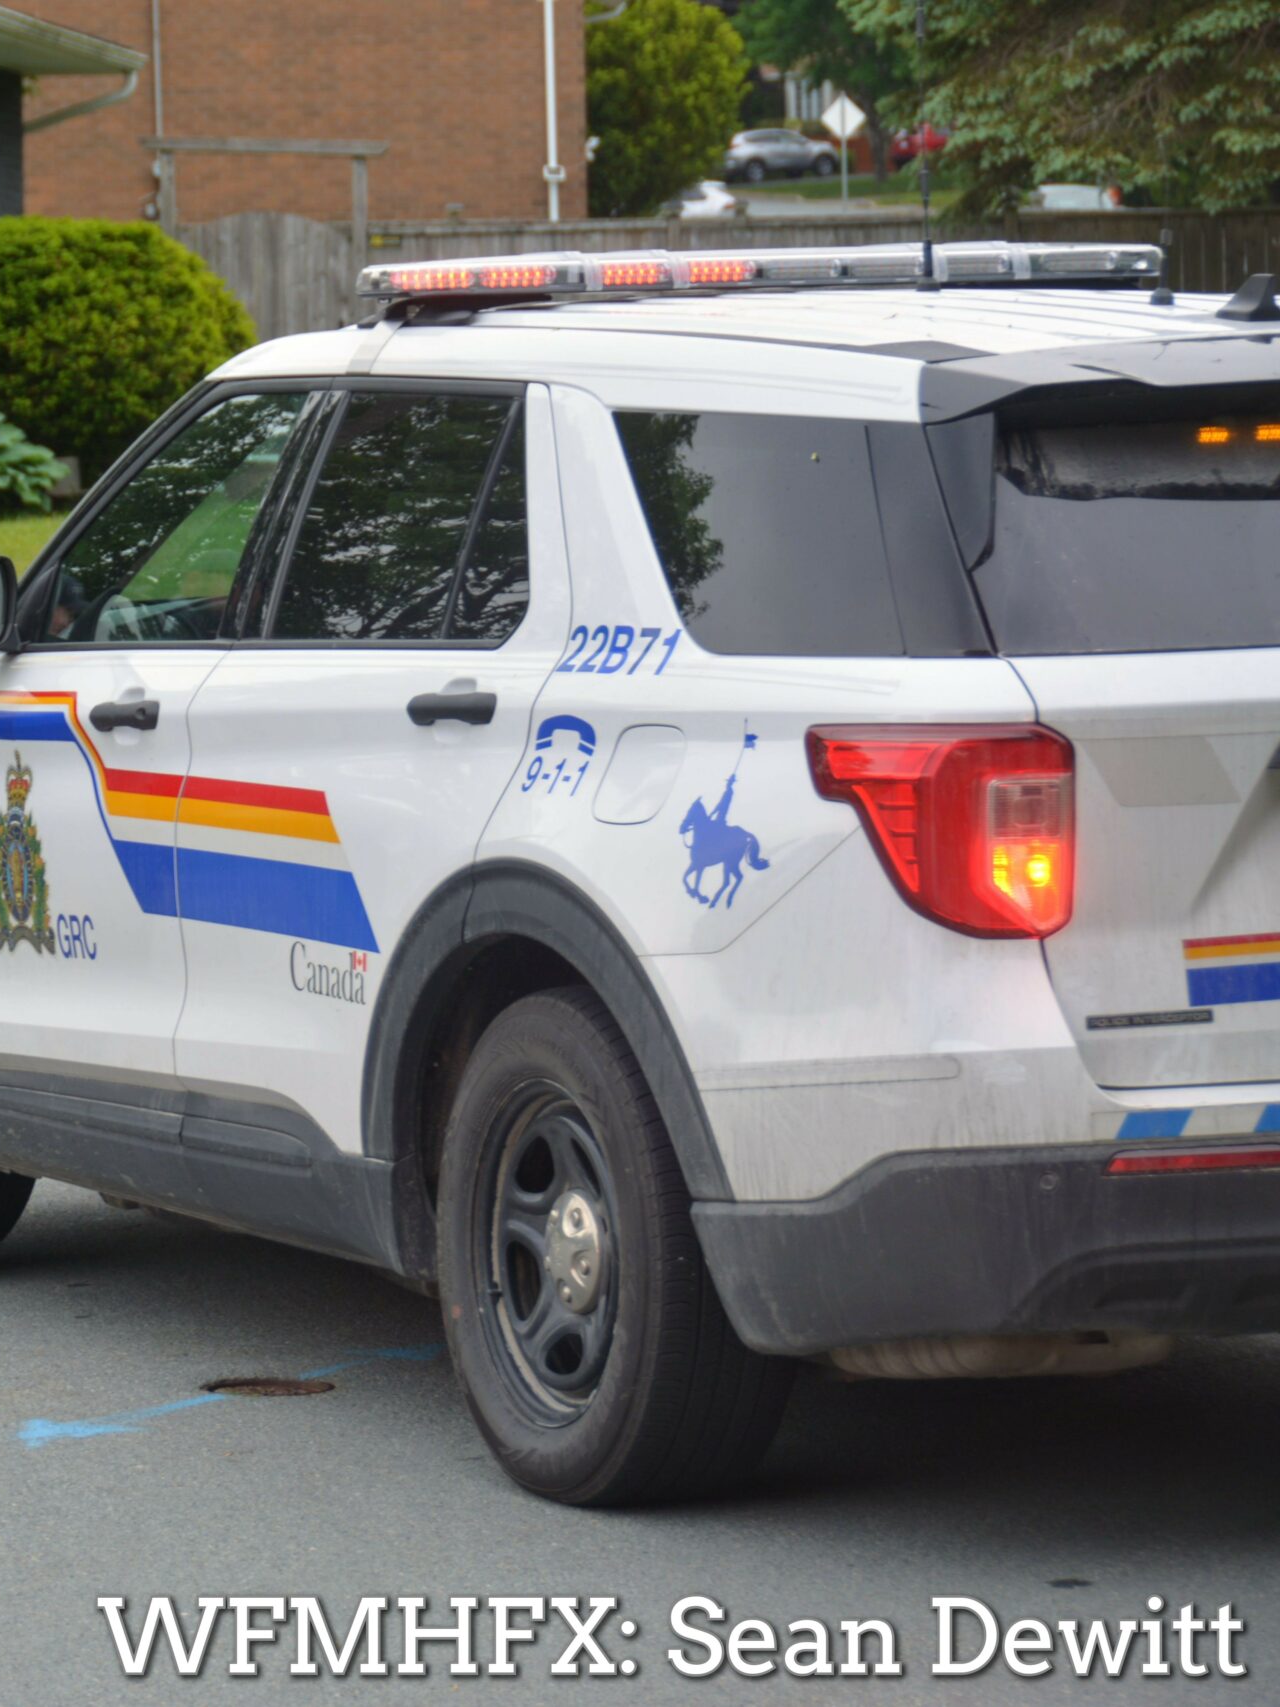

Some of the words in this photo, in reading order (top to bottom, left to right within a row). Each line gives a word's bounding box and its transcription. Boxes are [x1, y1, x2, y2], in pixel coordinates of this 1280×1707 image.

[555, 625, 682, 676] 22B71
[521, 755, 590, 797] 9-1-1
[56, 913, 97, 960] GRC
[290, 940, 366, 1006] Canada
